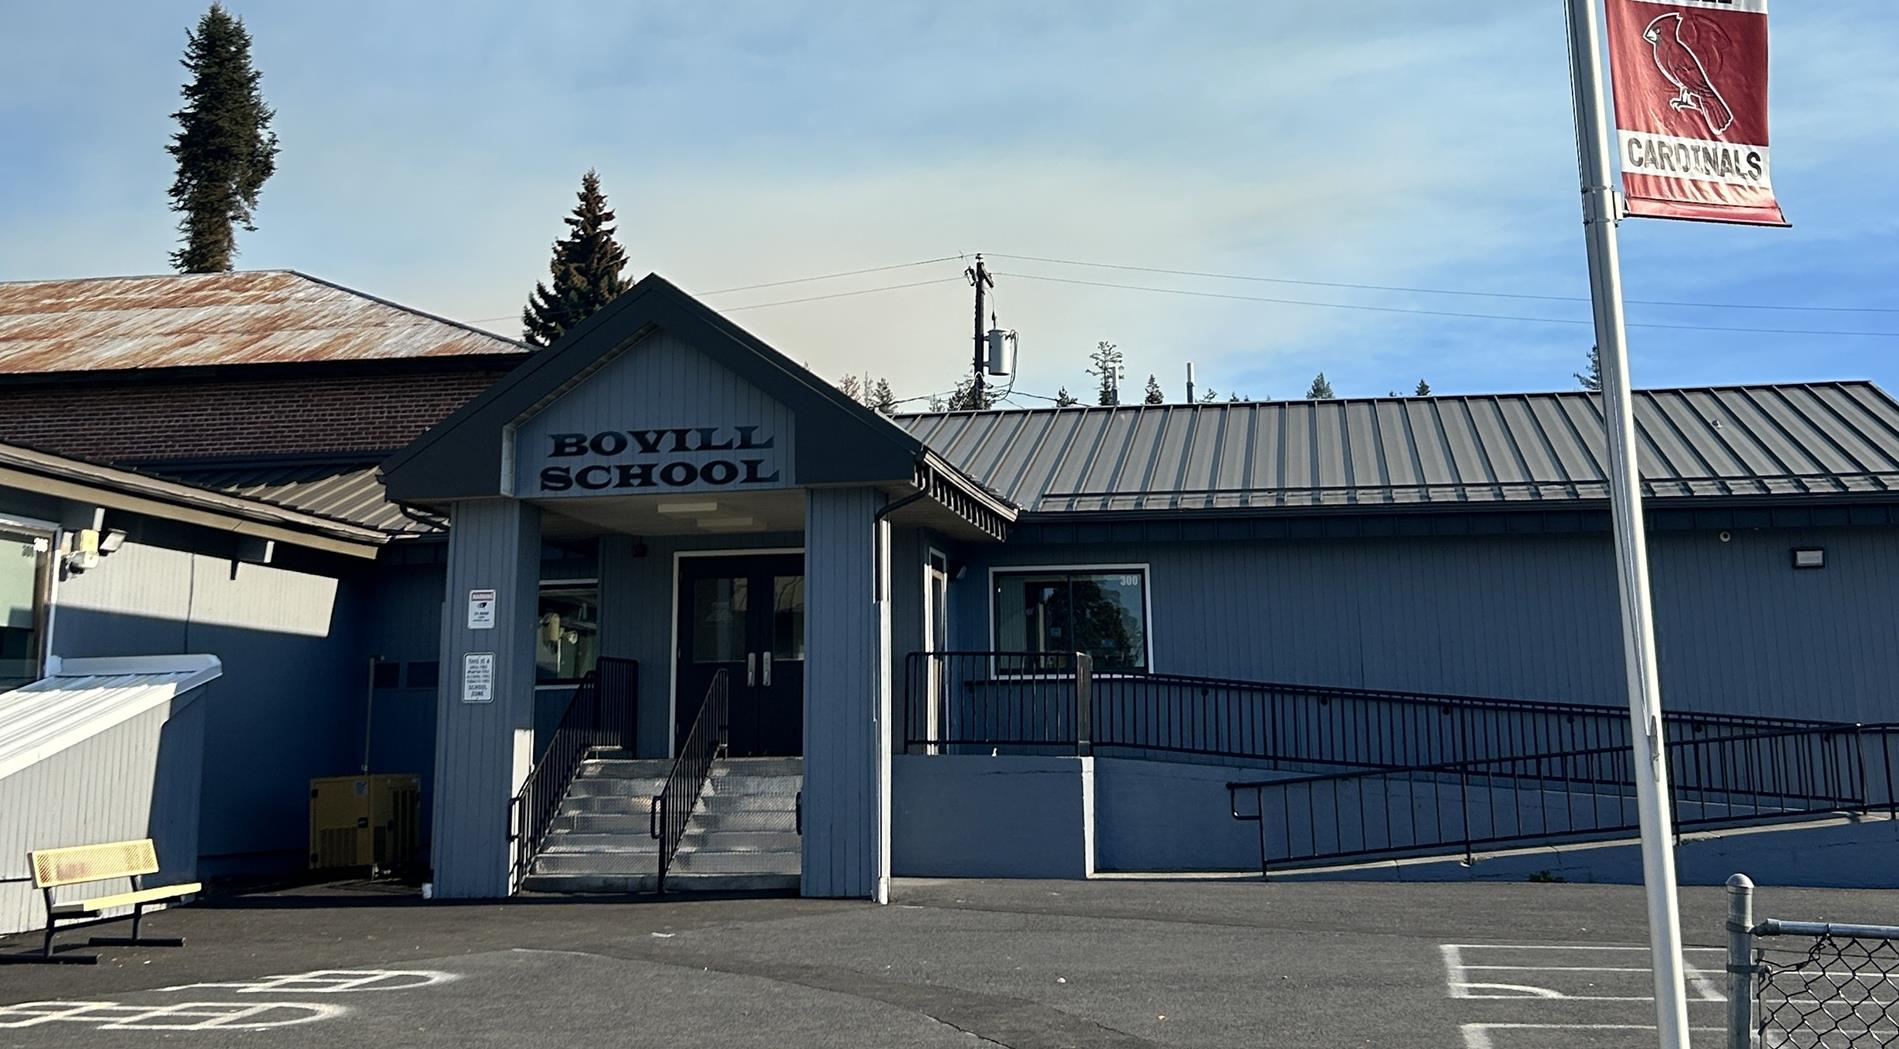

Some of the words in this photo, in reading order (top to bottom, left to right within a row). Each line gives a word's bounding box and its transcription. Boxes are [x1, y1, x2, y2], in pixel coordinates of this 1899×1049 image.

[1627, 137, 1762, 181] CARDINALS
[547, 425, 775, 458] BOVILL
[540, 459, 780, 491] SCHOOL
[1120, 575, 1138, 586] 300
